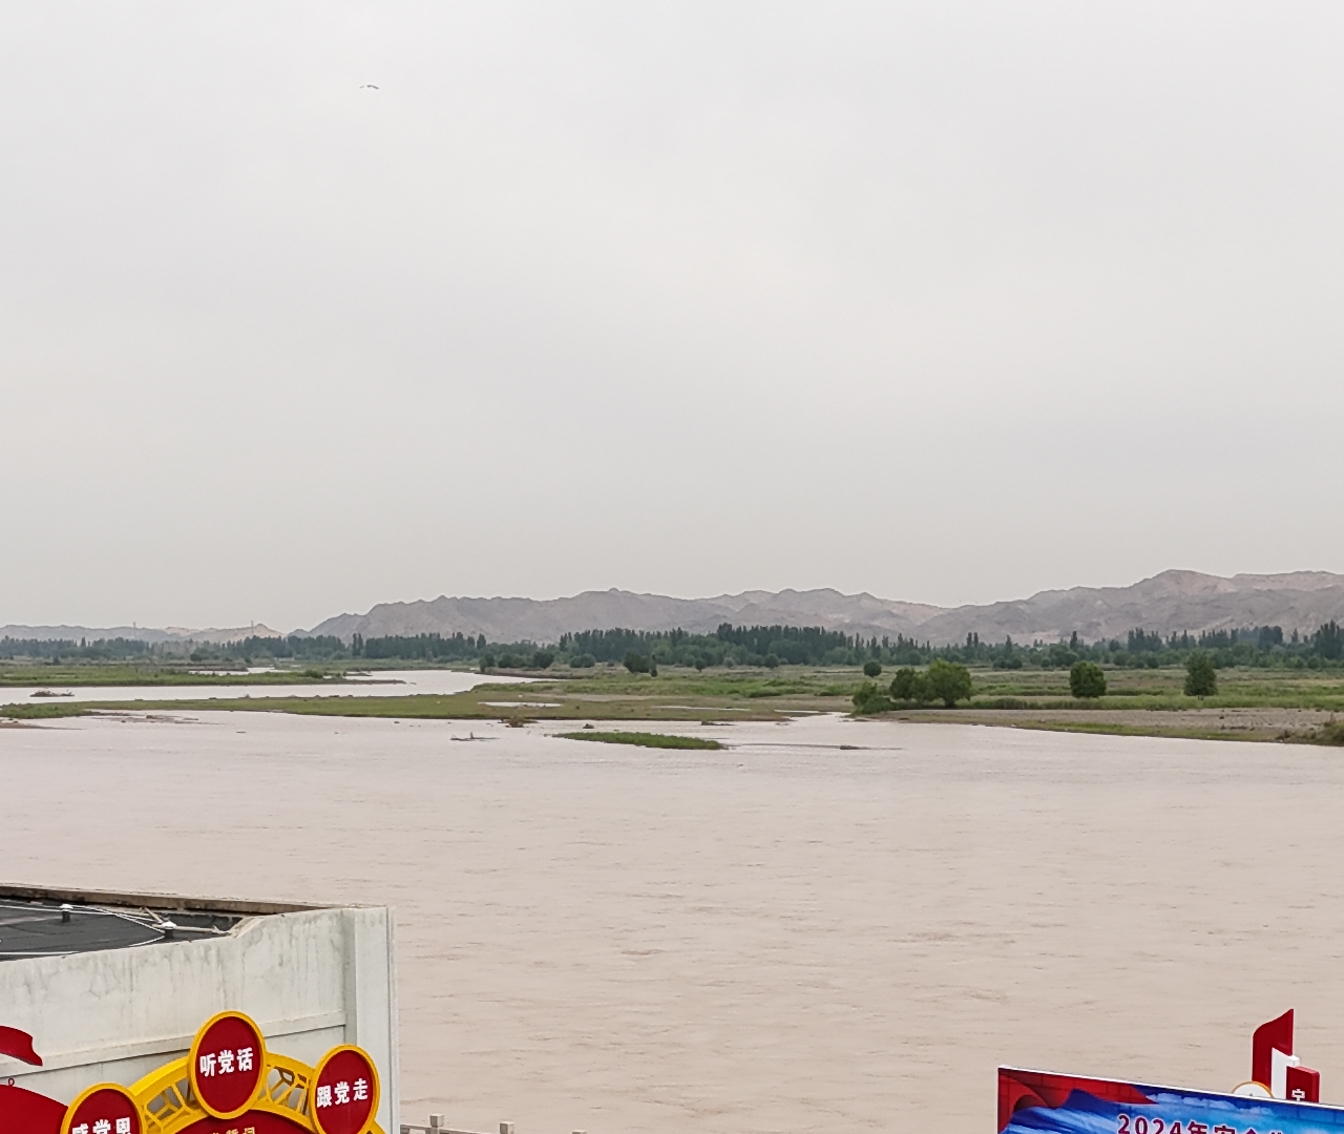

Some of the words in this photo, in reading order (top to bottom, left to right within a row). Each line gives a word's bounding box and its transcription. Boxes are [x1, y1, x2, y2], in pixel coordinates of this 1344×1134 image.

[199, 1047, 254, 1078] 听党话
[316, 1078, 369, 1108] 跟党走
